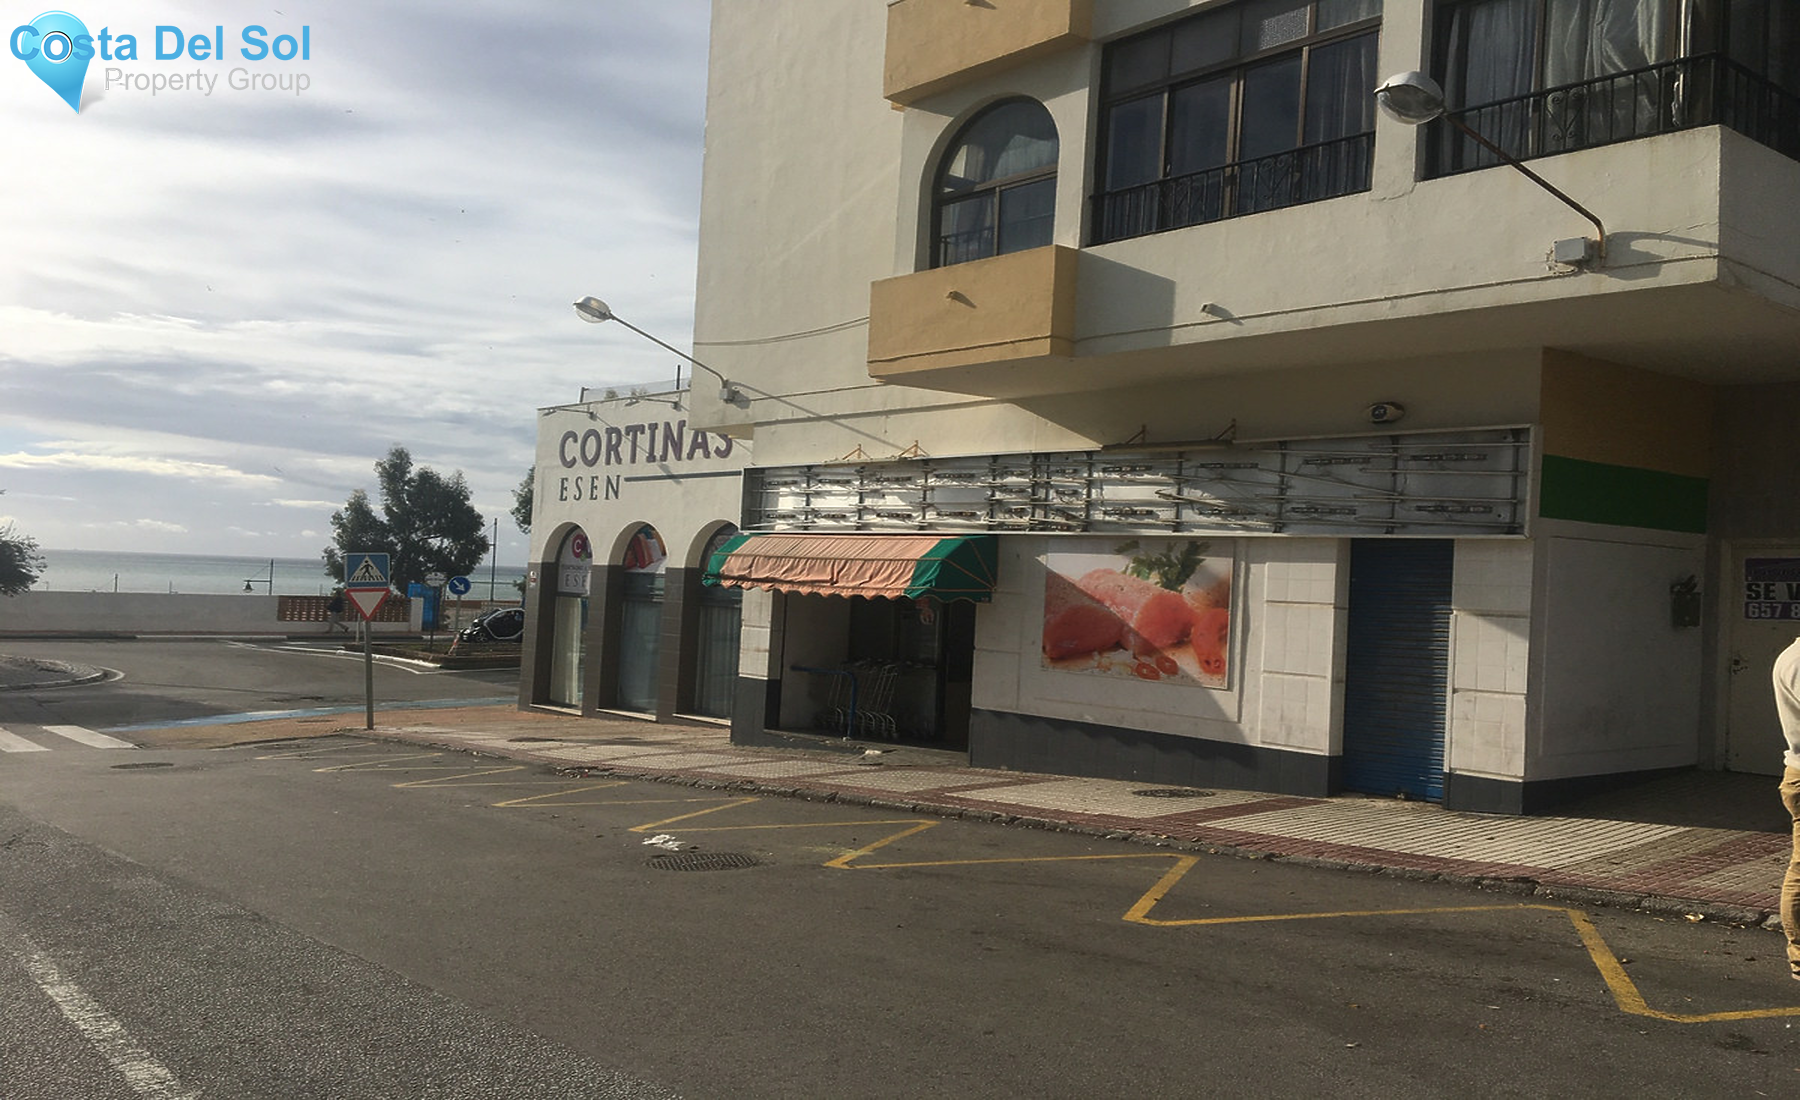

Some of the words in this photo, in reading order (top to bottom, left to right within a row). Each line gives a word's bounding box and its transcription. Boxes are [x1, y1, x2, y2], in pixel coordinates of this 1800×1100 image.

[559, 475, 621, 502] ESEN
[1746, 583, 1777, 600] SE
[1748, 603, 1782, 618] 657
